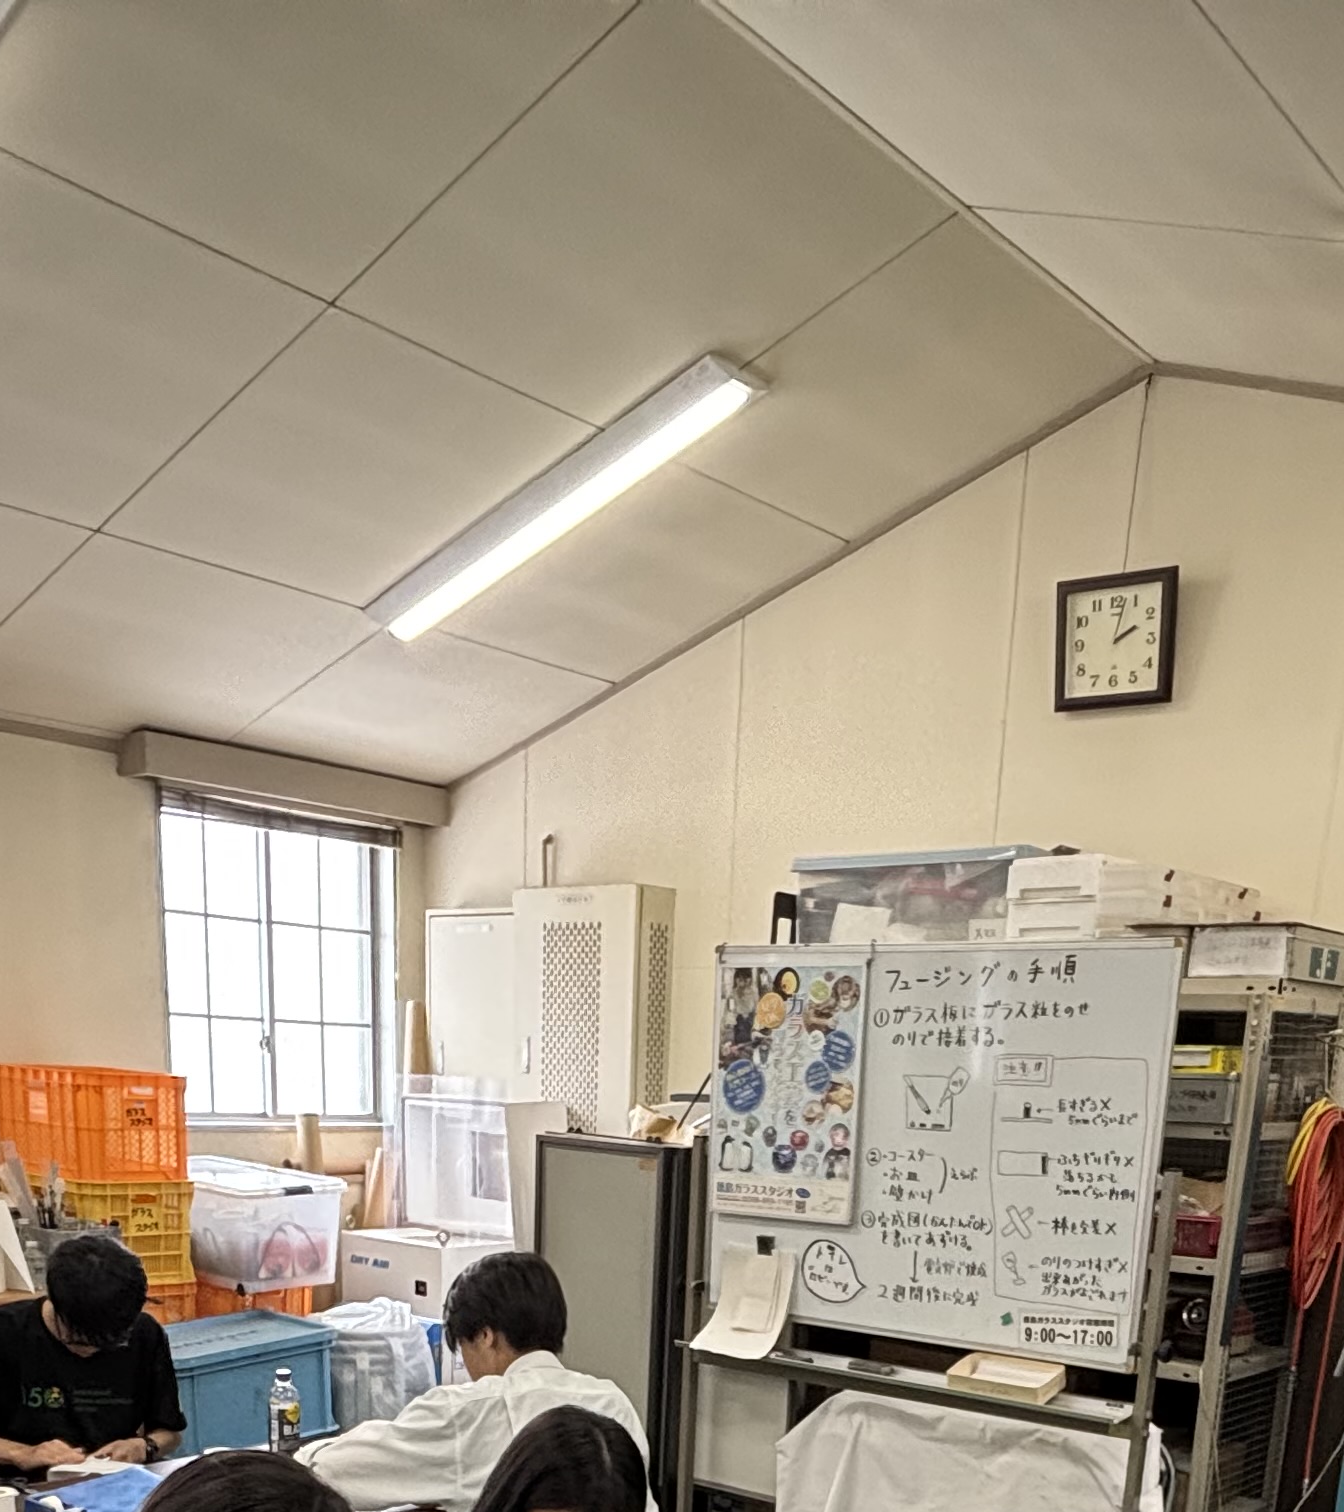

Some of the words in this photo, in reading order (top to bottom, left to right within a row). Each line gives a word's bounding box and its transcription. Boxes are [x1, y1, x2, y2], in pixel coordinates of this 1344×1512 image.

[1092, 600, 1103, 613] 11
[1109, 595, 1124, 609] 12
[1132, 594, 1139, 608] 1
[1145, 606, 1156, 620] 2
[1076, 615, 1089, 629] 10
[1145, 632, 1157, 645] 3
[1074, 639, 1085, 653] 9
[1076, 663, 1086, 677] 8
[1142, 657, 1154, 669] 4
[1089, 674, 1100, 688] 7
[1108, 674, 1119, 688] 6
[1127, 671, 1138, 684] 5
[885, 954, 1078, 993] フュージングの手順
[350, 1254, 370, 1267] DRY
[371, 1258, 390, 1270] AIR
